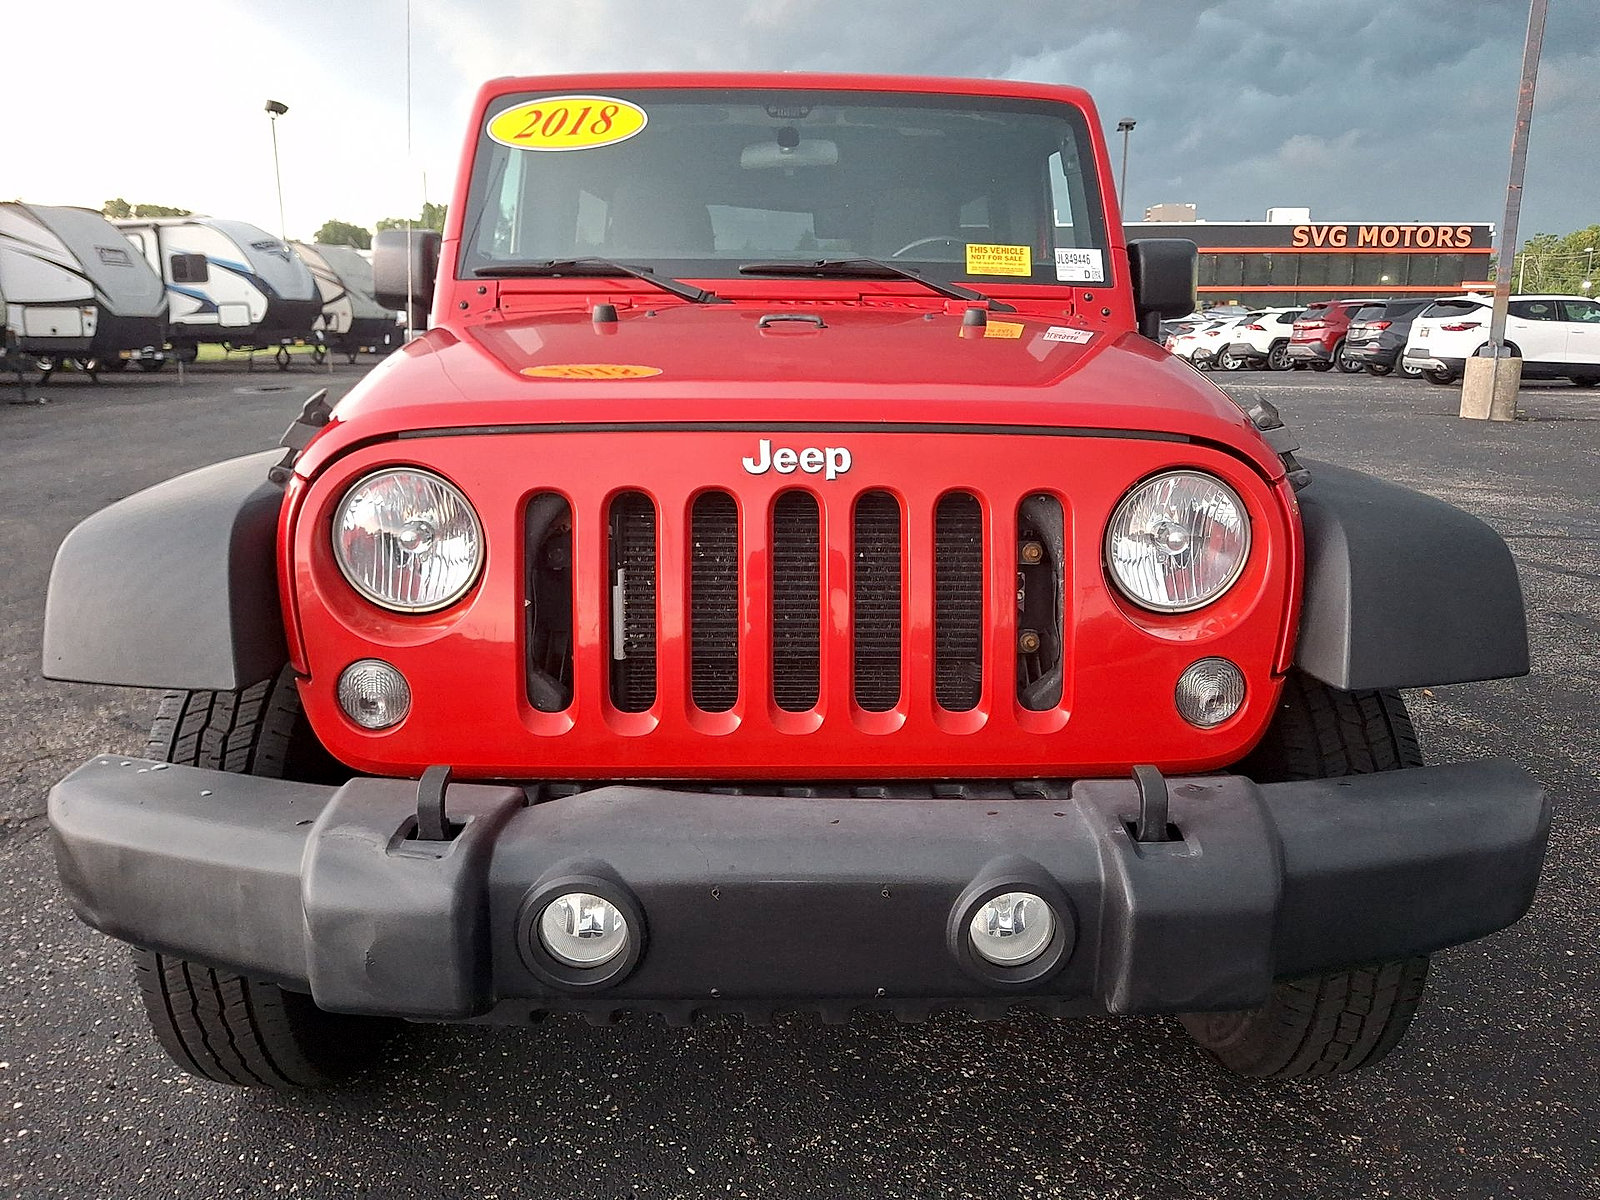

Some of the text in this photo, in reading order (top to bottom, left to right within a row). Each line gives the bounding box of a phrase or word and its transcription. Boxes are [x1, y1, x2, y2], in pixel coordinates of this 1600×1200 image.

[513, 104, 619, 139] 2018
[969, 246, 1025, 256] THIS VEHICLE
[1292, 225, 1473, 248] SVG MOTORS
[742, 438, 853, 481] Jeep
